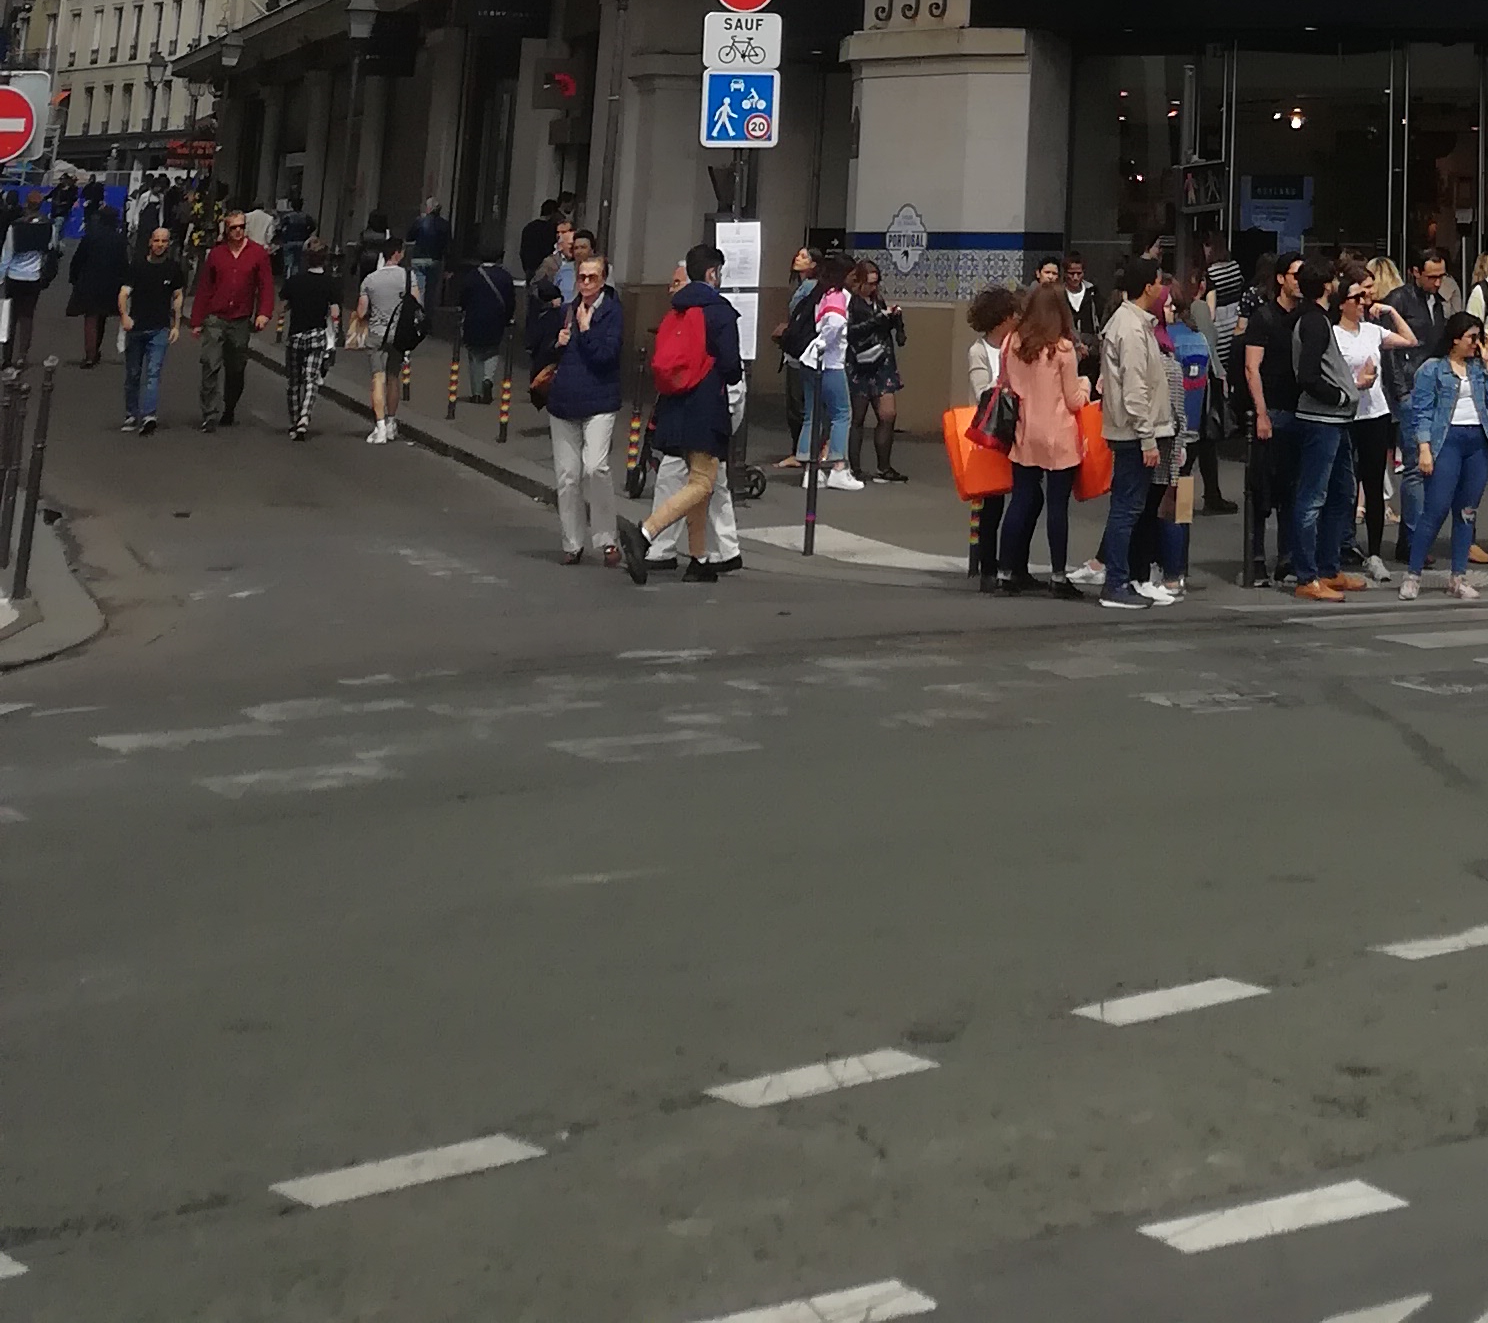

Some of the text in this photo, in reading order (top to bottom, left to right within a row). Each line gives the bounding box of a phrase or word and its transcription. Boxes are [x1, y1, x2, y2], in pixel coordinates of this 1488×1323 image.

[724, 17, 764, 31] SAUF
[750, 122, 765, 132] 20
[888, 234, 924, 248] PORTUGAL
